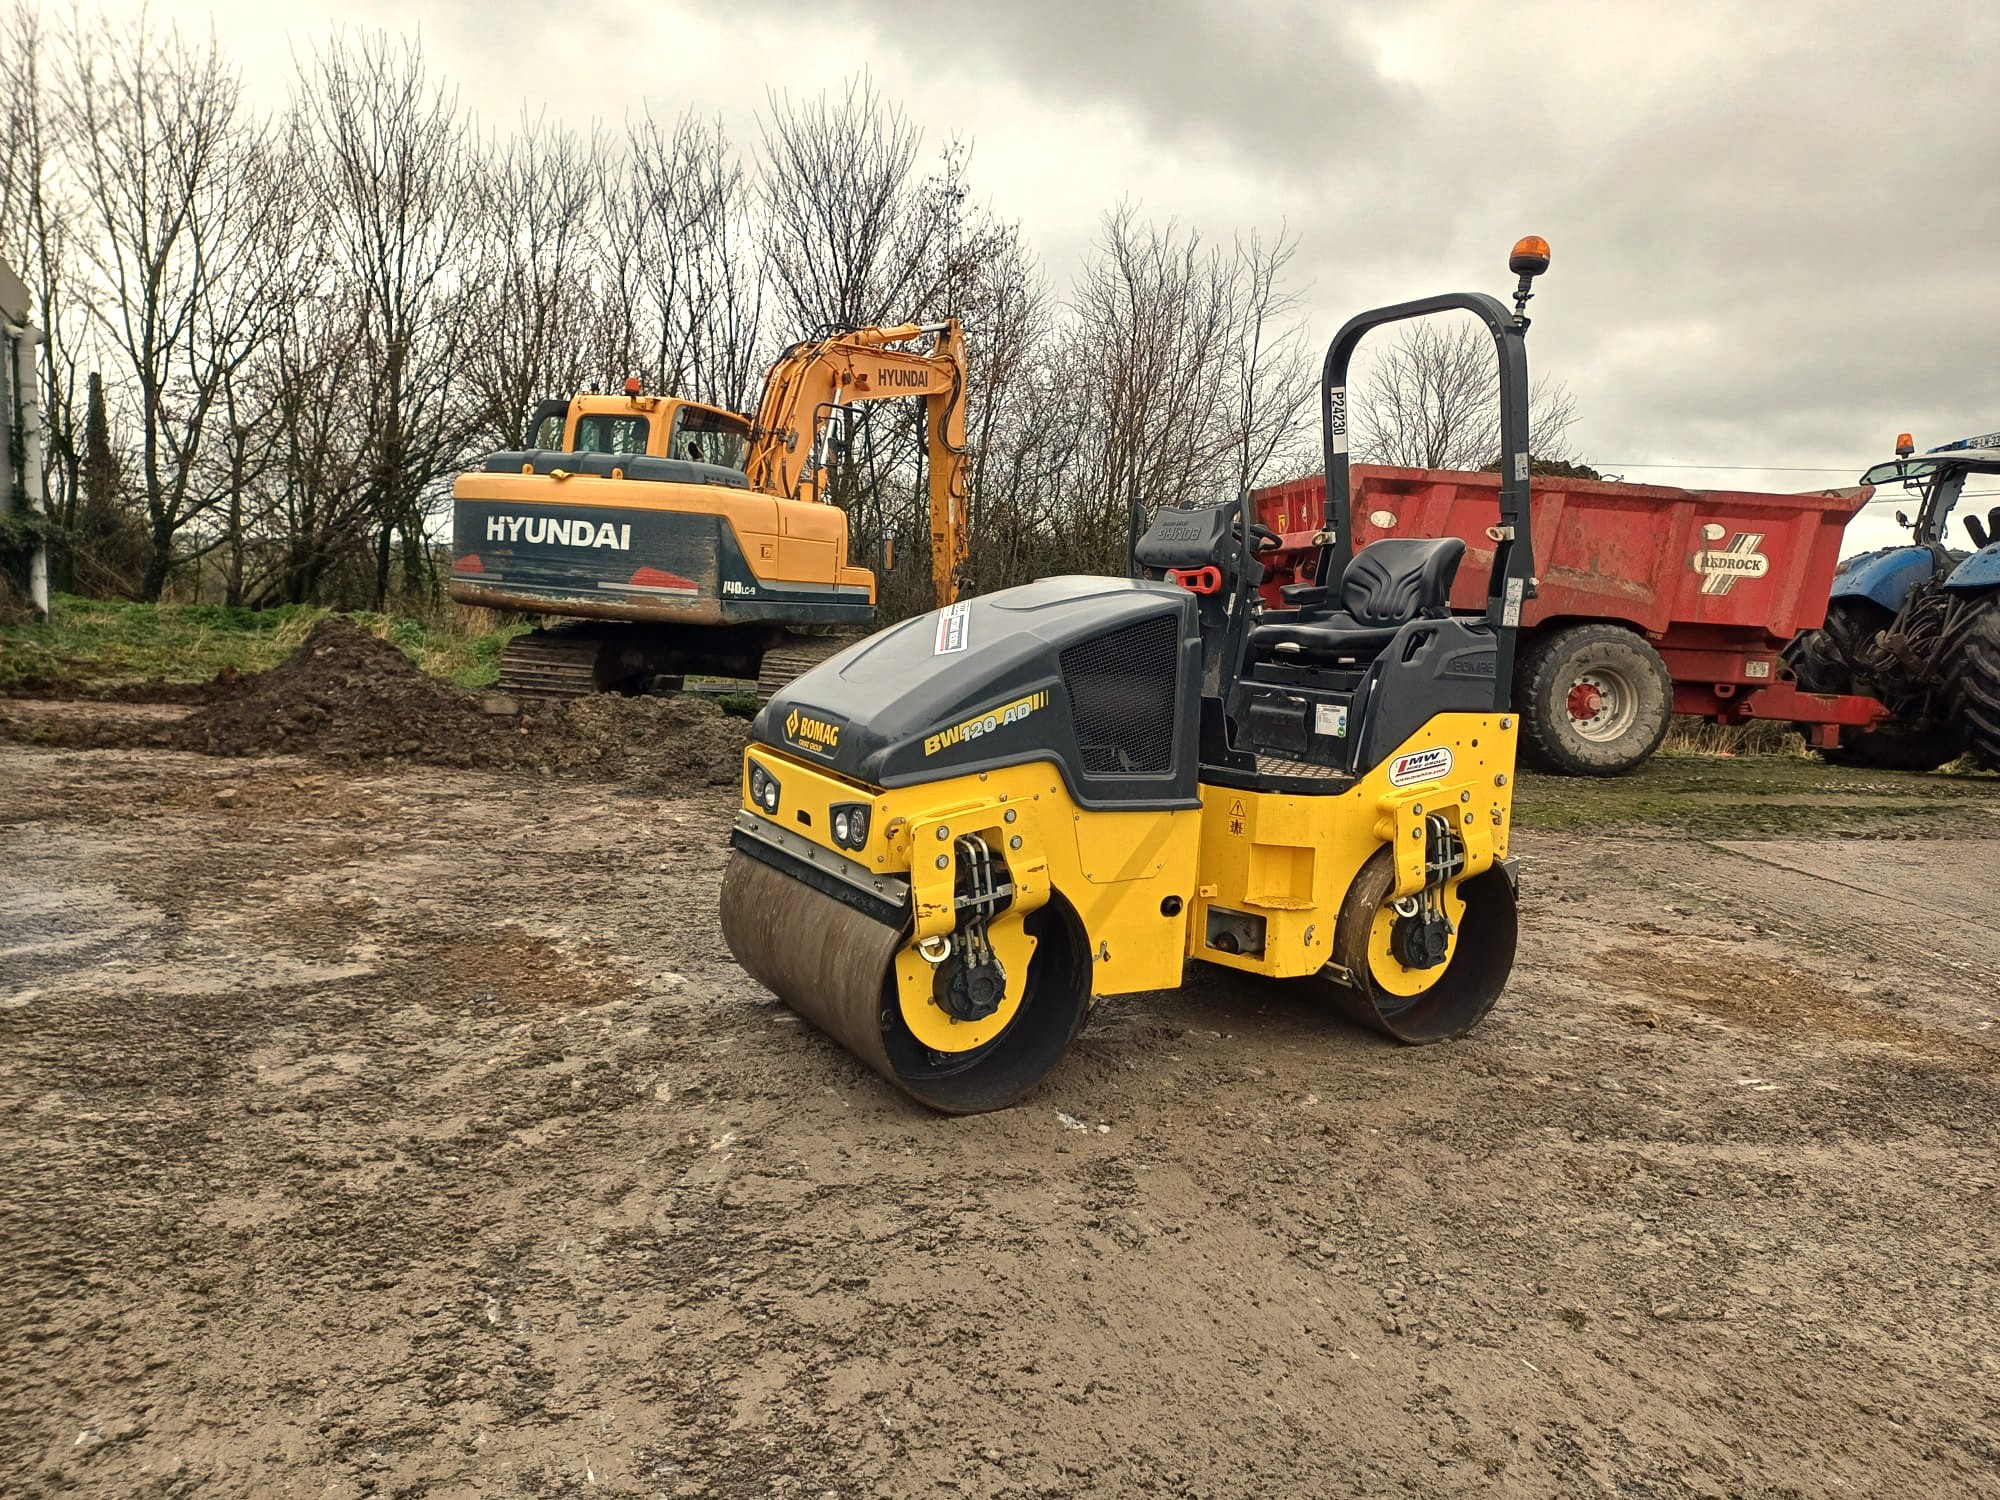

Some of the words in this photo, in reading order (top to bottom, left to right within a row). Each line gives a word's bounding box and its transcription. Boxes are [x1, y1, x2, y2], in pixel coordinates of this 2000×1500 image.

[878, 368, 929, 388] HYUNDAI
[1331, 391, 1346, 436] P24230
[486, 515, 632, 551] HYUNDAI
[1701, 556, 1762, 571] REDROCK
[800, 717, 840, 747] BOMAG
